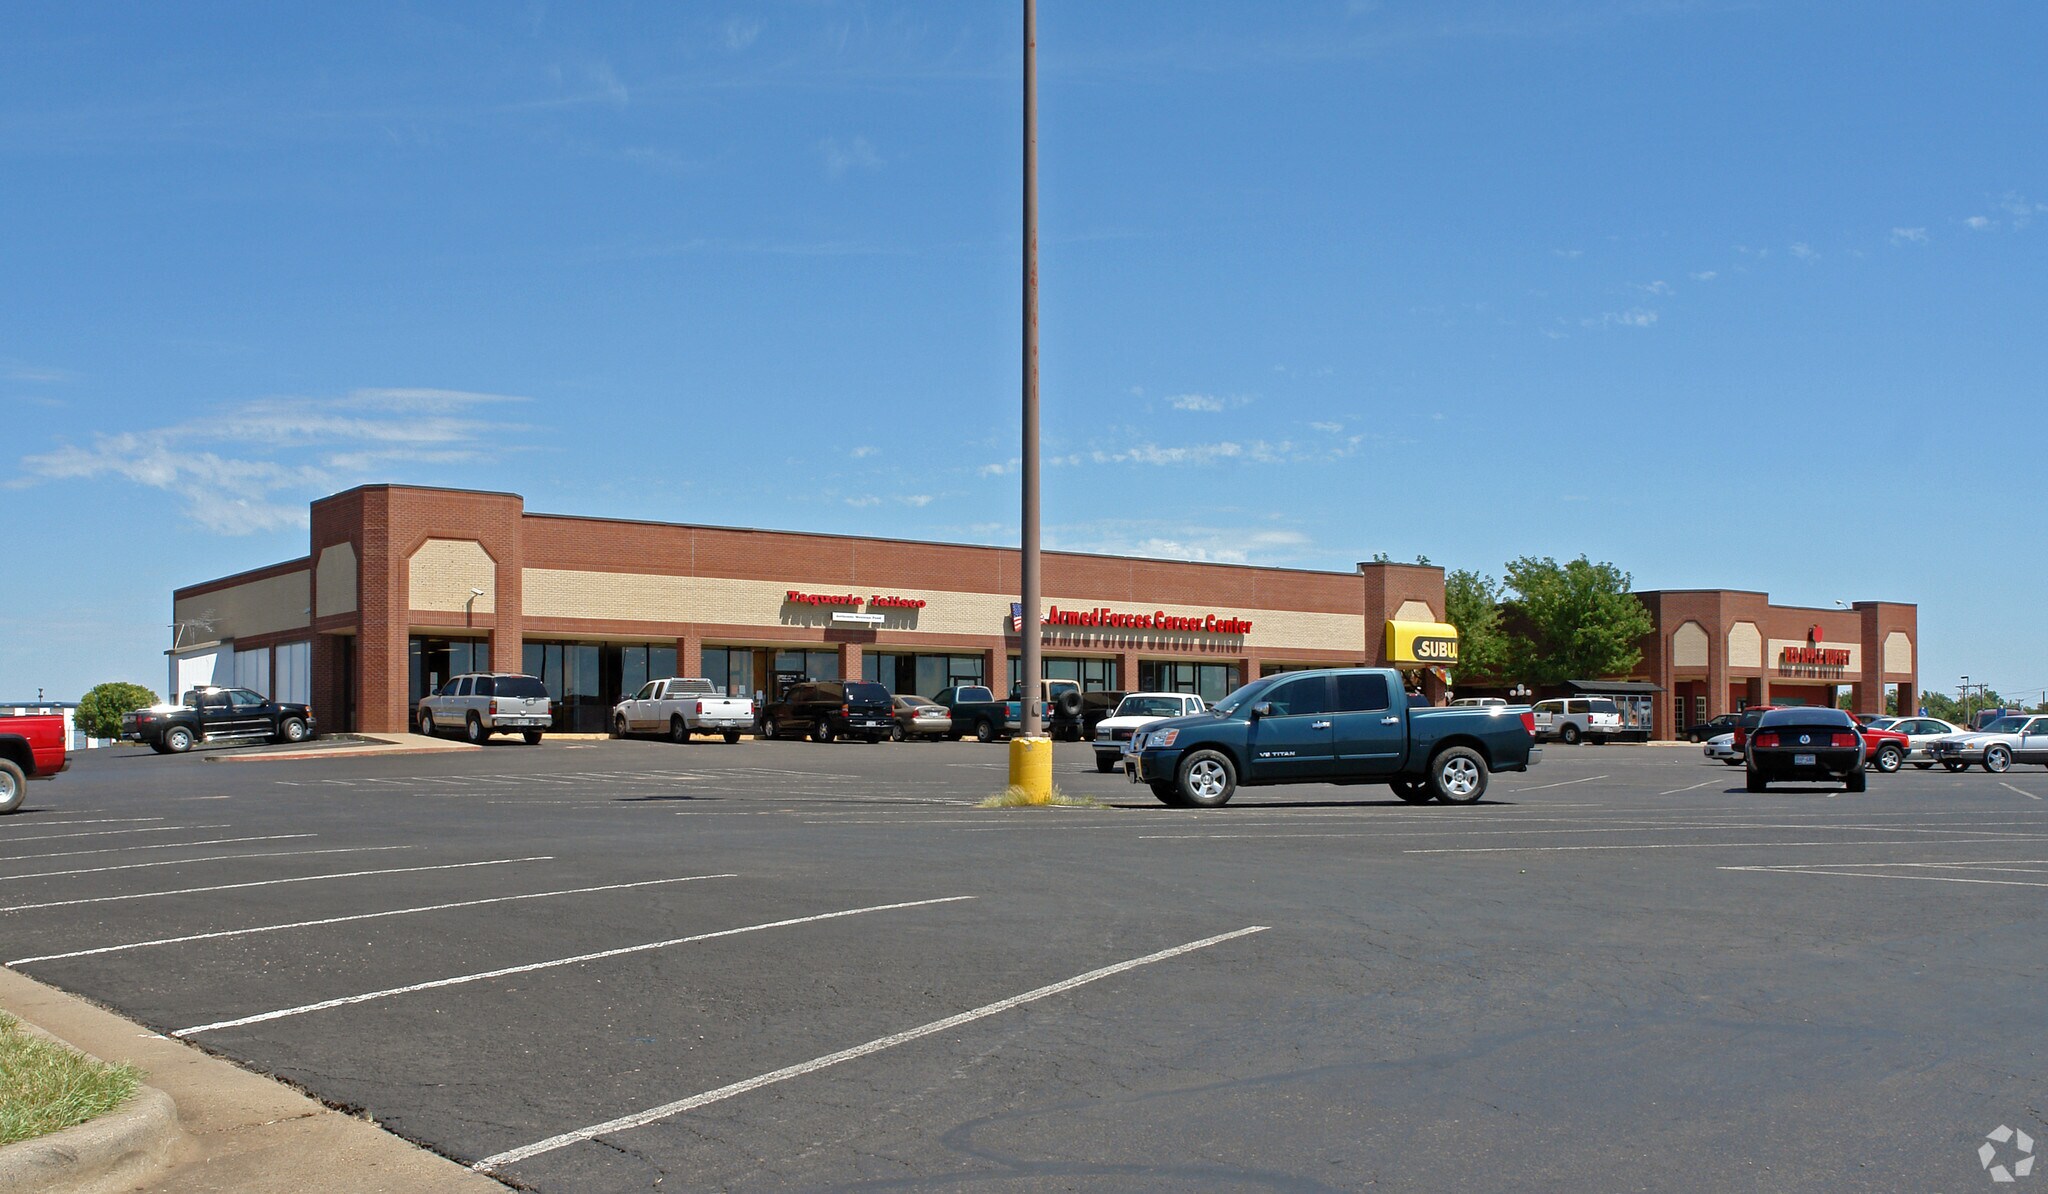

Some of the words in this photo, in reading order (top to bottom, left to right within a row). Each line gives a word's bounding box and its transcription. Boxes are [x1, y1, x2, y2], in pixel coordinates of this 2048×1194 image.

[787, 591, 864, 606] Taqueria
[871, 595, 926, 608] Jalisco
[1050, 605, 1099, 626] Armed
[1101, 608, 1152, 629] Forces
[1154, 610, 1203, 631] Career
[1206, 613, 1252, 634] Center
